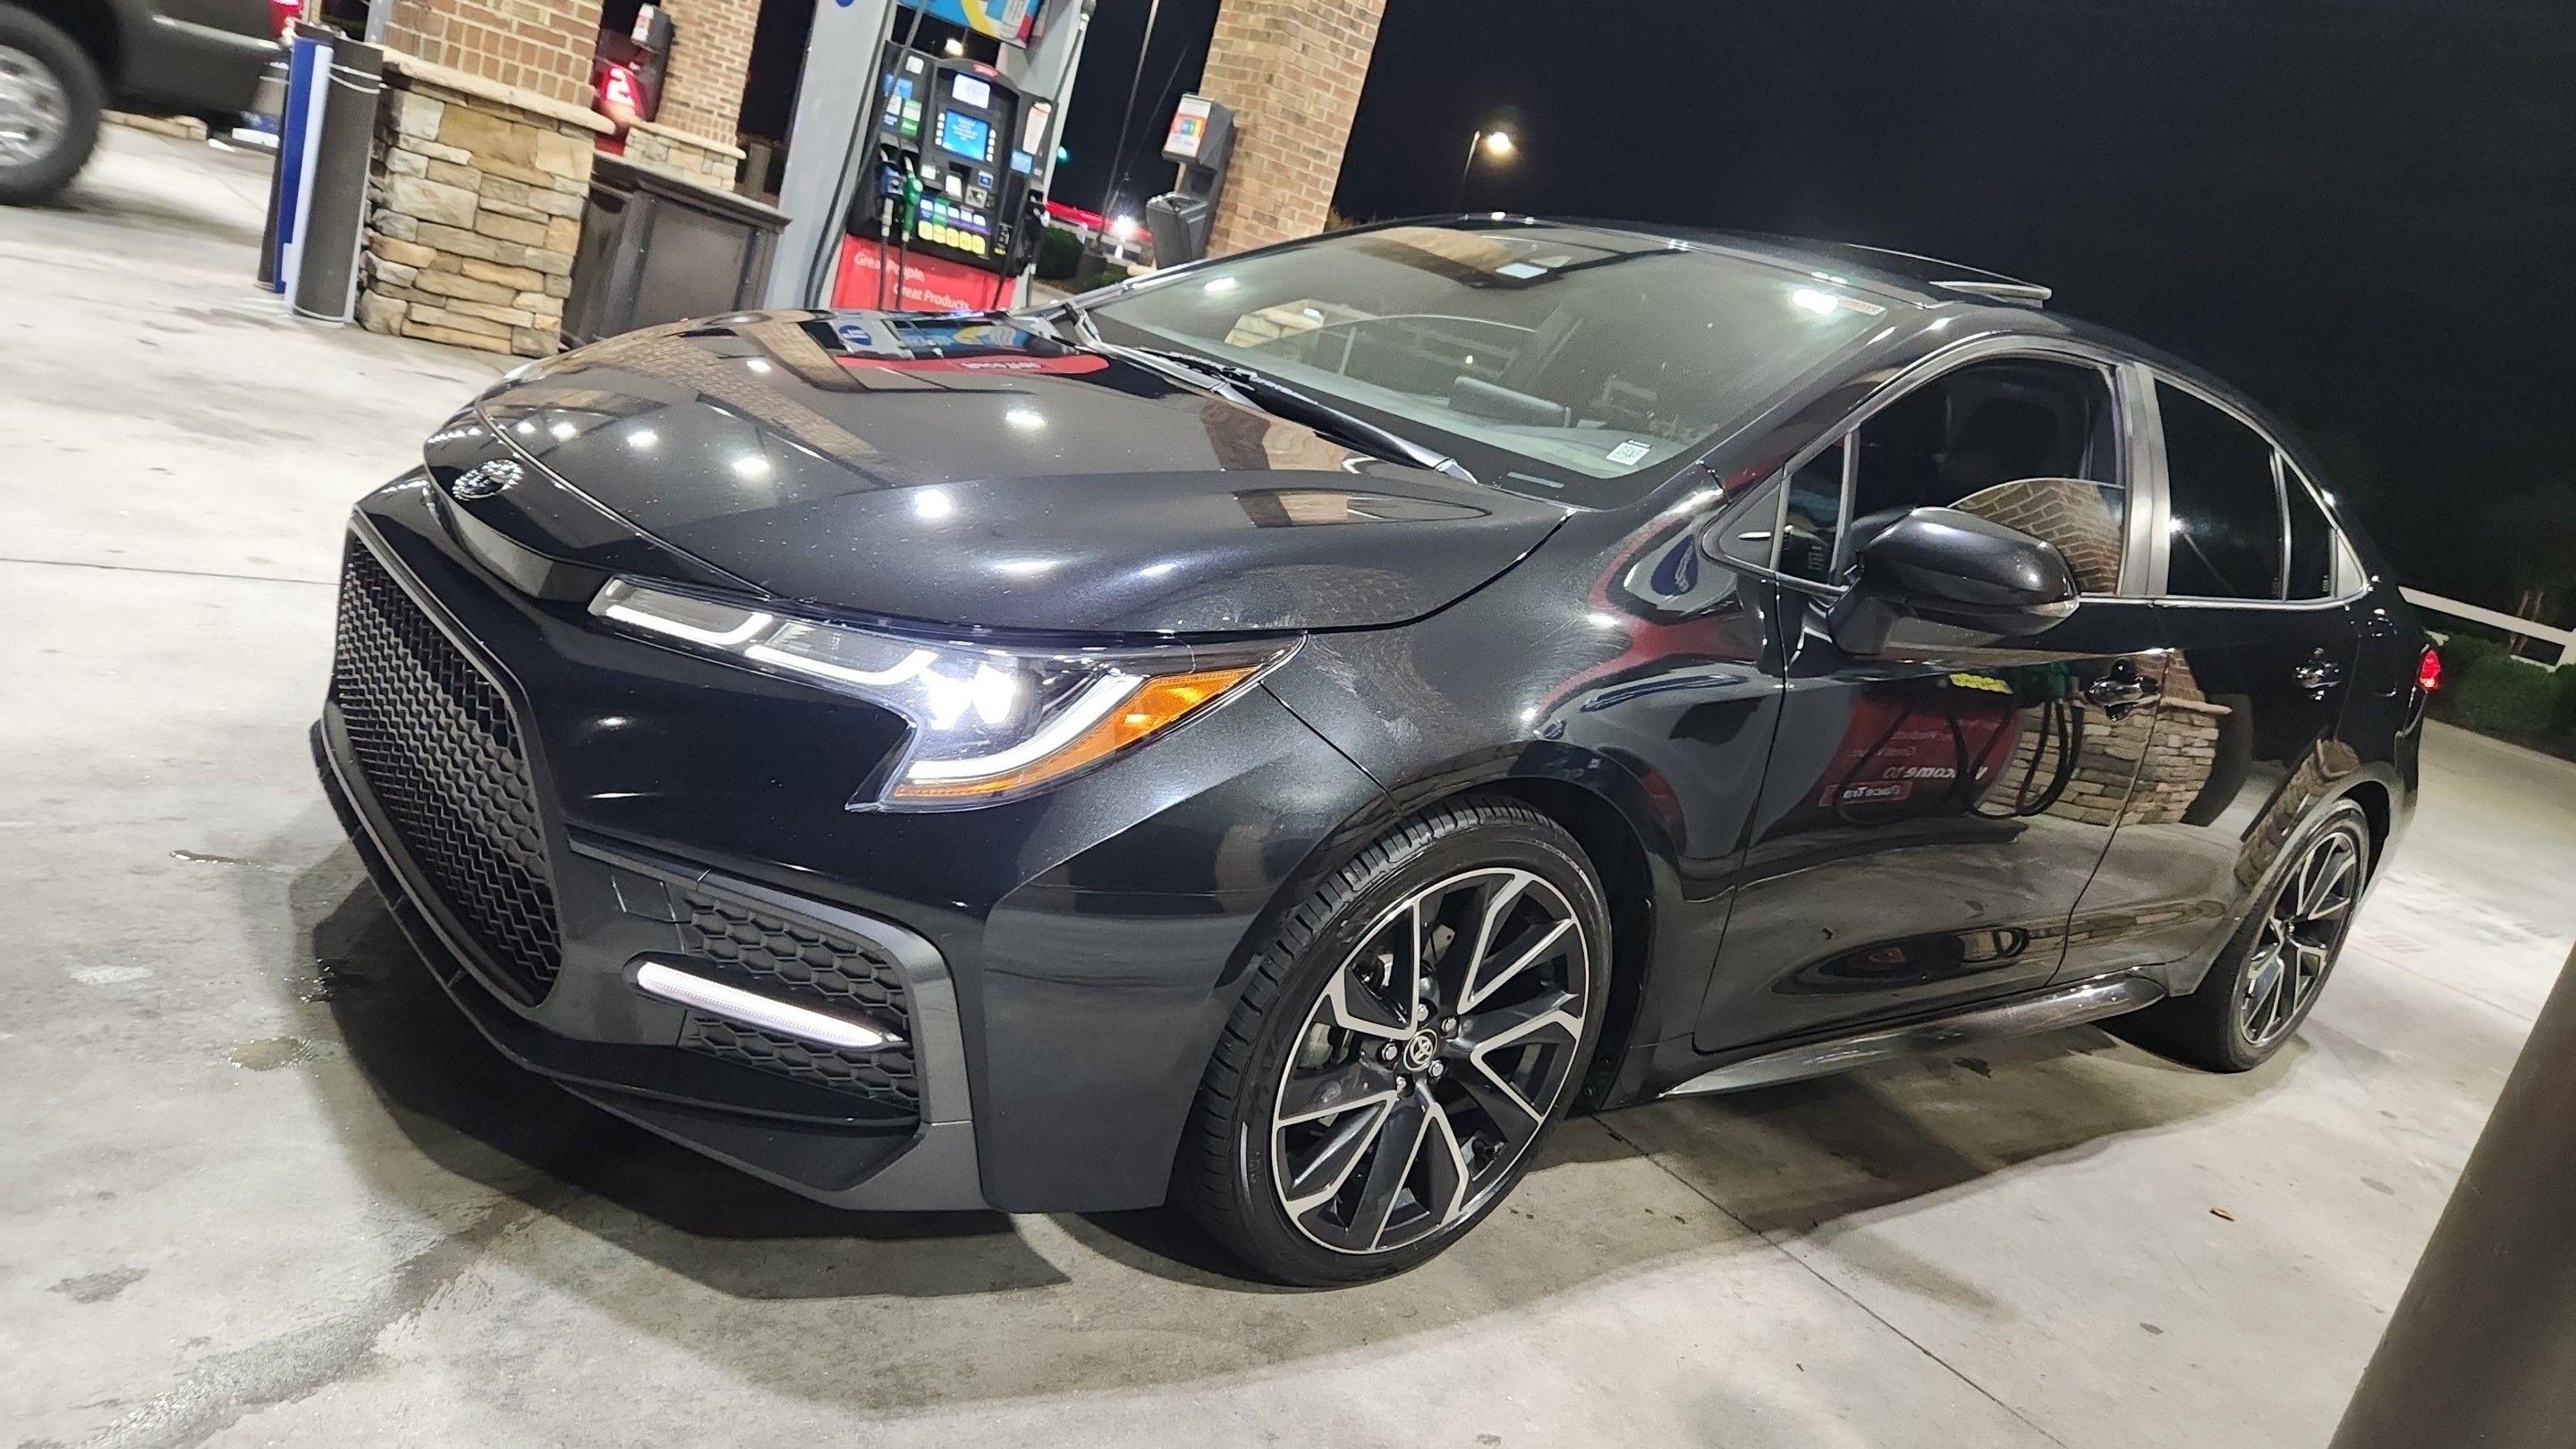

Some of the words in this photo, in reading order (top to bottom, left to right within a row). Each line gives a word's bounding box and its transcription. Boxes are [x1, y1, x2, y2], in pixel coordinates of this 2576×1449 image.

[606, 67, 635, 107] 2
[853, 250, 882, 270] Grea
[885, 258, 926, 283] Peple,
